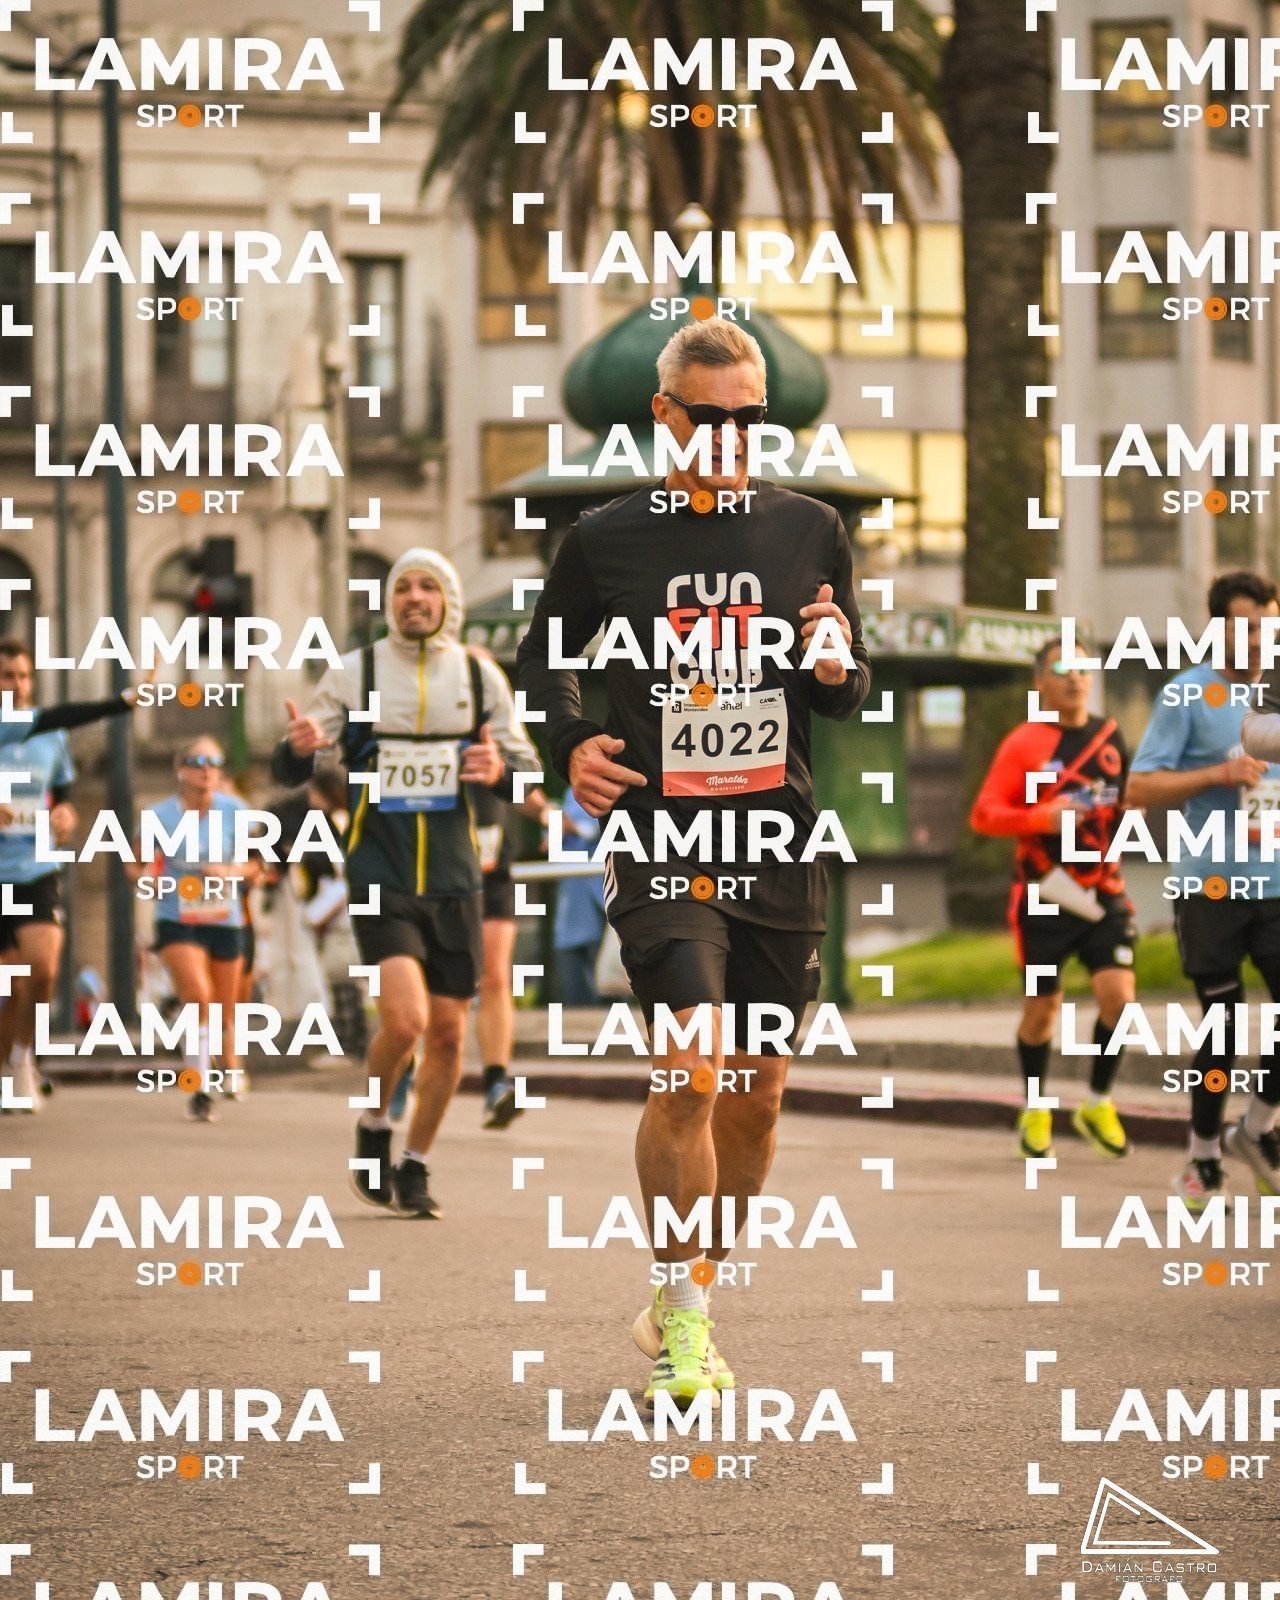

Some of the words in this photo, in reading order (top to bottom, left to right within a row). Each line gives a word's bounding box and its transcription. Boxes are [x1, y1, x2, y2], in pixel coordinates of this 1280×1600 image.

[667, 572, 762, 608] run
[671, 719, 779, 757] 4022
[384, 764, 451, 787] 7057
[706, 775, 749, 786] Maratón
